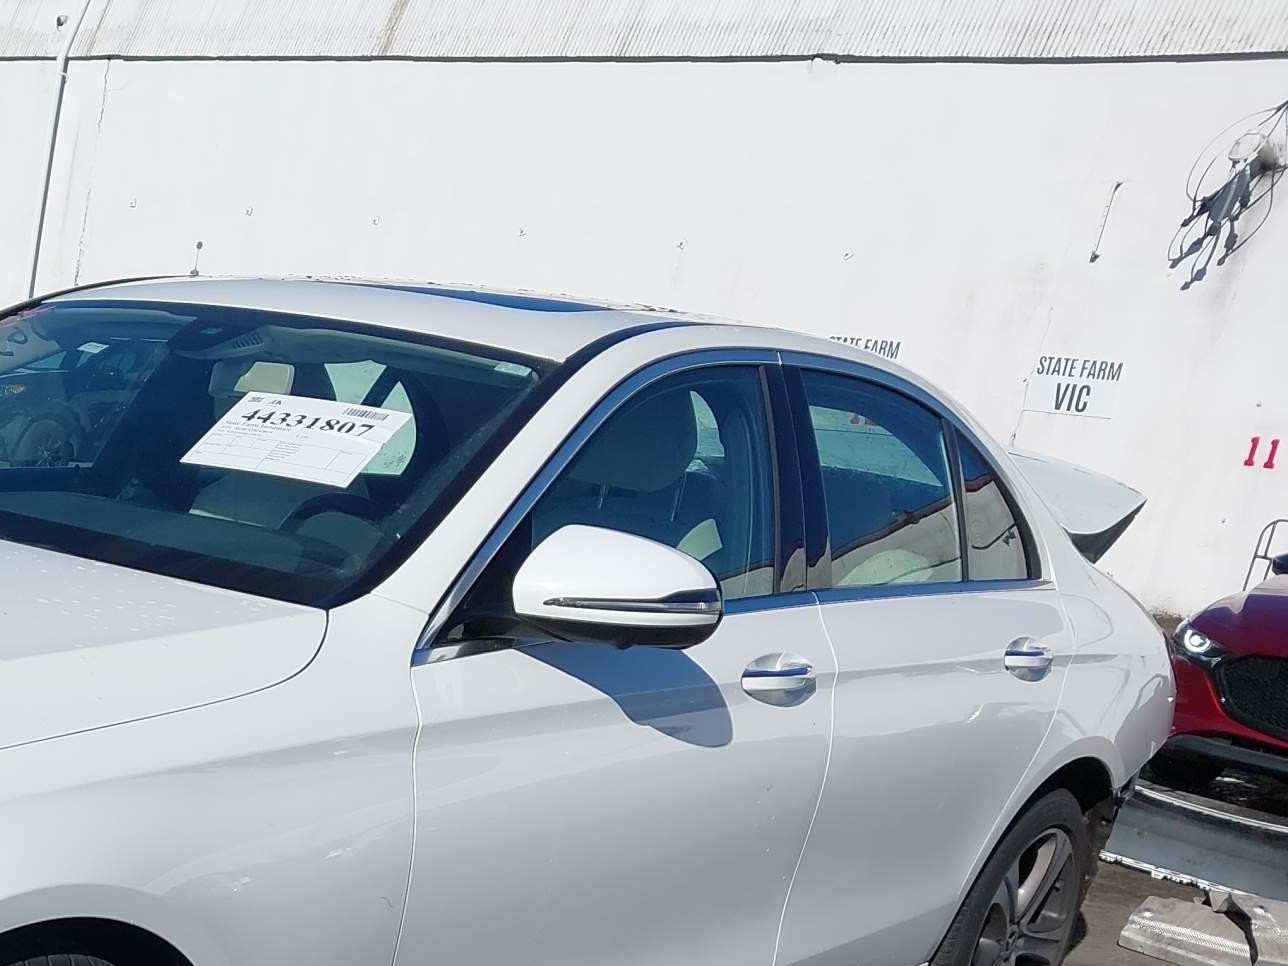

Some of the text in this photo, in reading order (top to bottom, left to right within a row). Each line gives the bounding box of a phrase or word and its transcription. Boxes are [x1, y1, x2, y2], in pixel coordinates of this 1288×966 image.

[1036, 355, 1124, 381] STATE FARM
[1054, 382, 1091, 413] VIC
[241, 409, 375, 437] 44331807
[1243, 436, 1281, 469] 11
